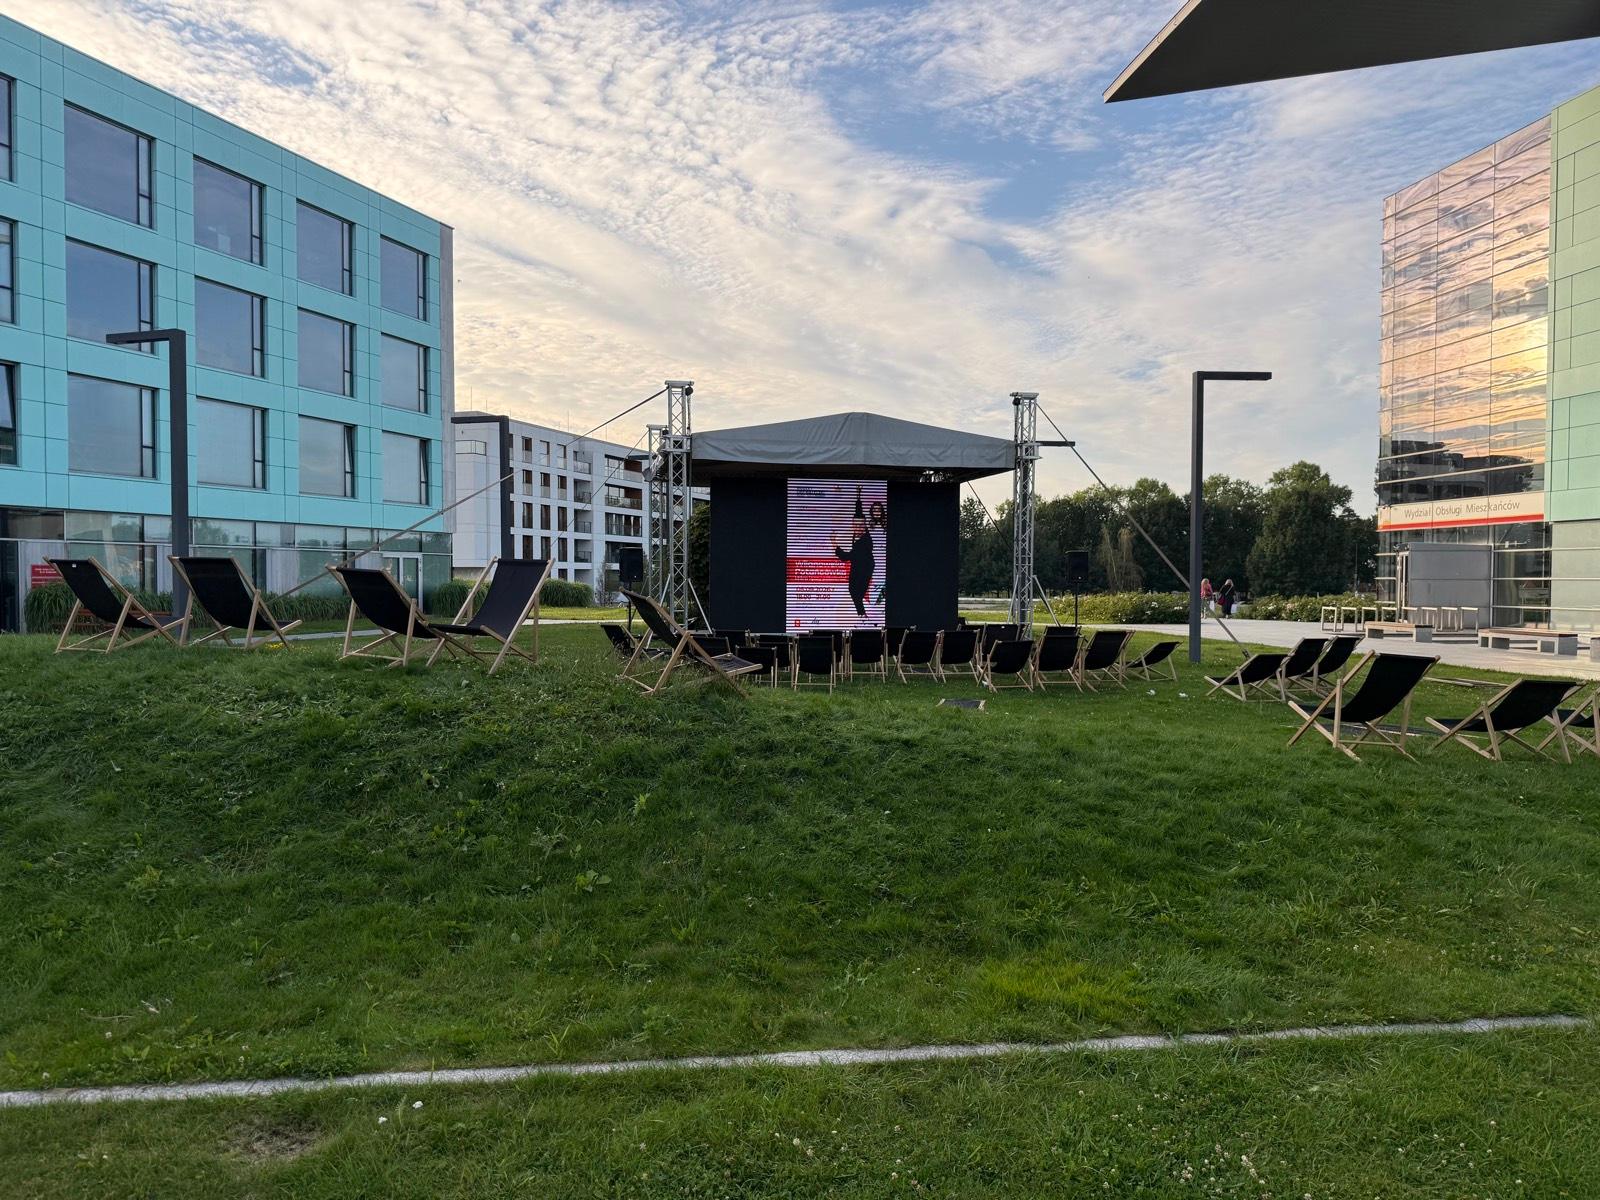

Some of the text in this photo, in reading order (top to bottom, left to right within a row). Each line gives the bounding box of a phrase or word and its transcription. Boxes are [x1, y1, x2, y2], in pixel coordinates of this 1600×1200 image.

[1404, 501, 1520, 520] Wydział Obsługi Mieszkańców
